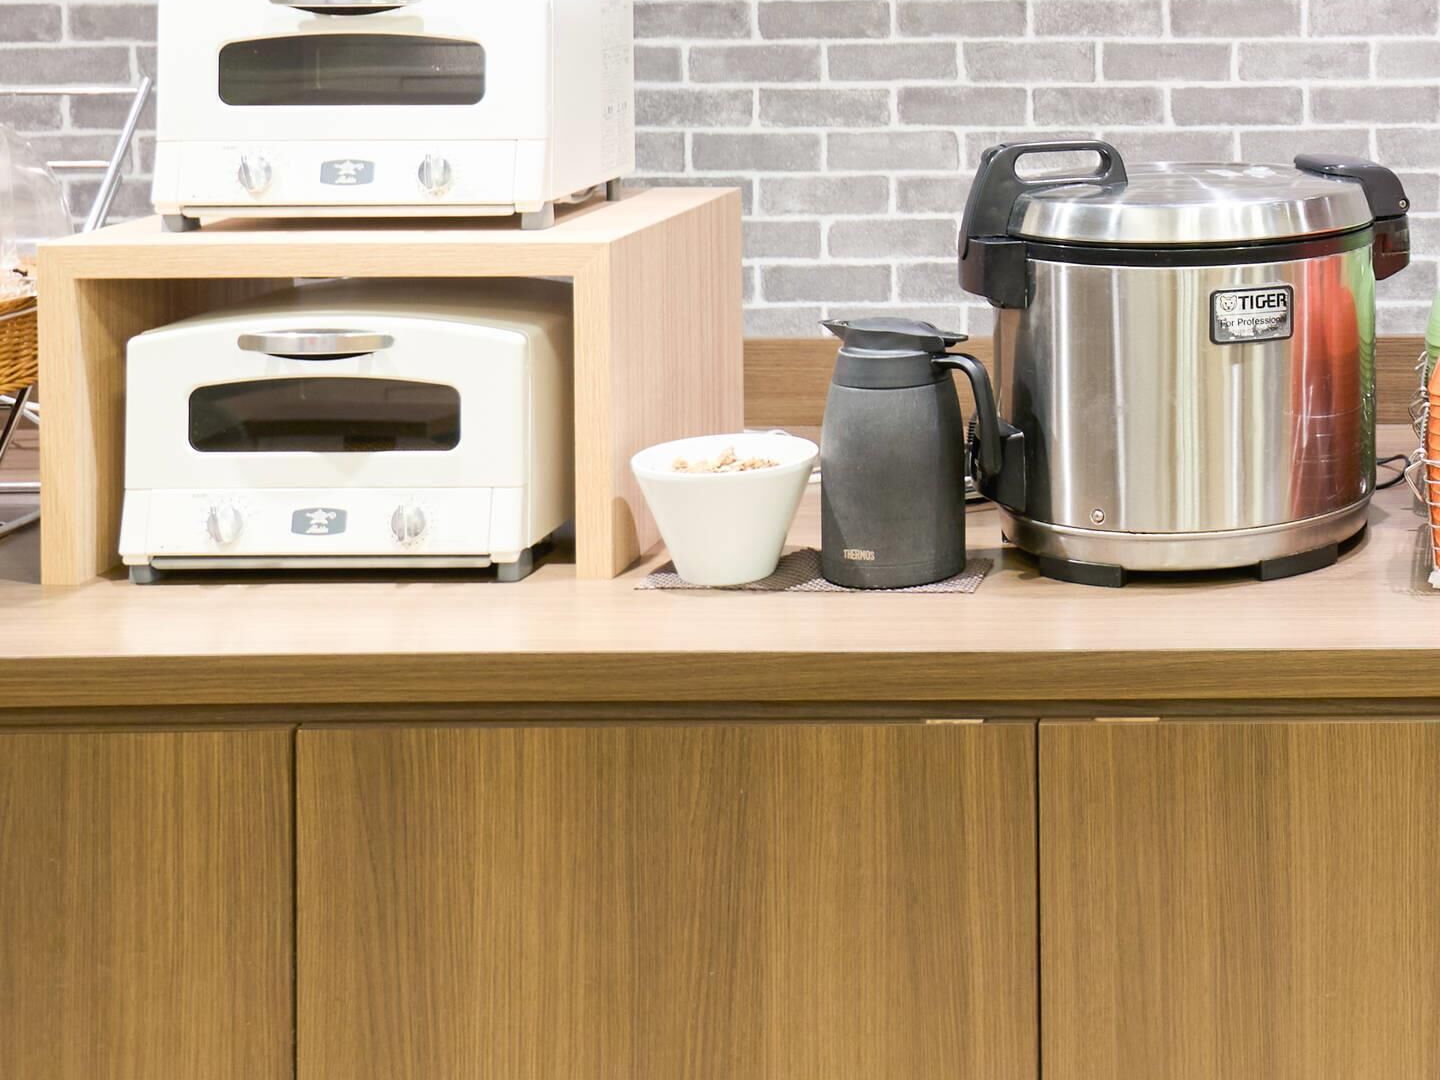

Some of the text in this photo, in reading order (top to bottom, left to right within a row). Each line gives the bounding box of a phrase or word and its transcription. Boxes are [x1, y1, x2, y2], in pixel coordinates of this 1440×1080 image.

[1238, 293, 1287, 310] TIGER
[1220, 319, 1234, 328] For
[843, 549, 875, 560] THERMOS
